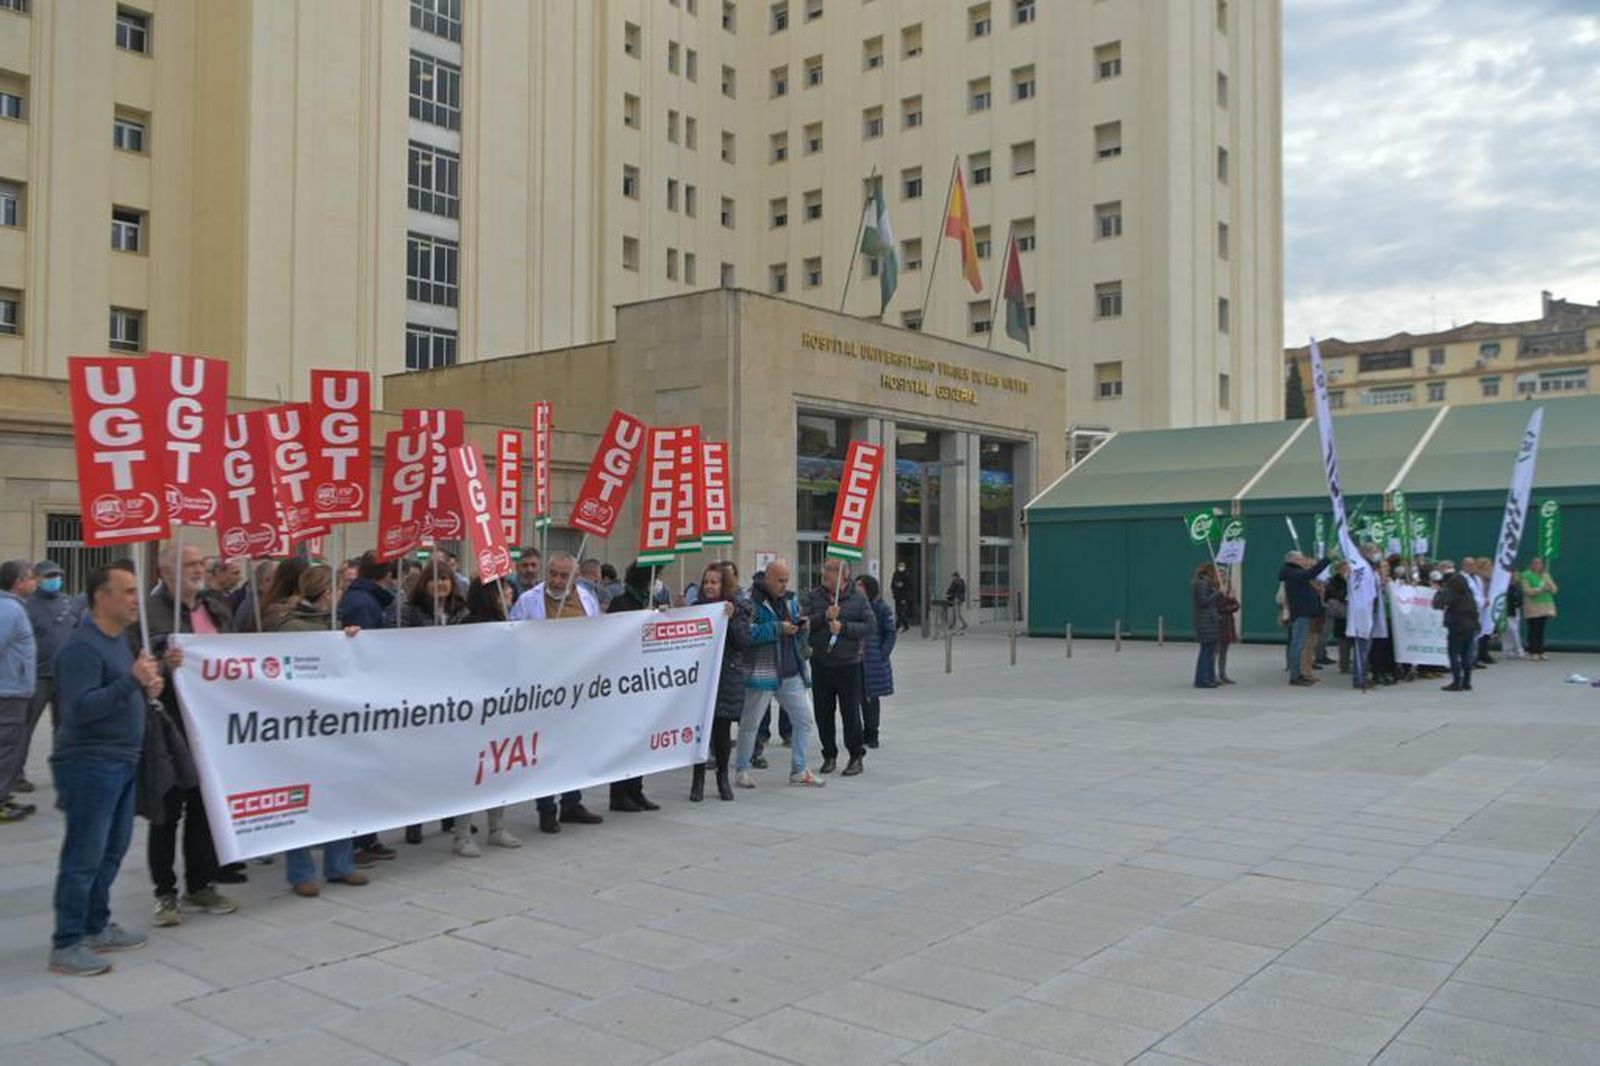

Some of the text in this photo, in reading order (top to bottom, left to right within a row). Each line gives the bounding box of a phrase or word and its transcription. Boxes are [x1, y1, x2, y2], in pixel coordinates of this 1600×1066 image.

[801, 331, 858, 359] HOSPITAL
[880, 373, 930, 397] HOSPITAL
[84, 365, 146, 491] UGT
[166, 355, 205, 484] UGT
[267, 409, 311, 503] UGT
[321, 377, 360, 481] UGT
[598, 418, 642, 502] UGT
[223, 413, 256, 525] UGT
[391, 431, 428, 523] UGT
[459, 444, 493, 547] UGT
[501, 433, 518, 545] CCOO
[646, 430, 676, 548] CCOO
[703, 444, 727, 531] CCOO
[836, 445, 878, 545] CCOO
[201, 656, 257, 682] UGT
[656, 623, 698, 638] CCOO
[227, 660, 701, 746] Mantenimiento público y de calidad
[650, 728, 680, 751] UGT
[229, 790, 289, 815] CCOO
[474, 731, 540, 786] ¡YA!
